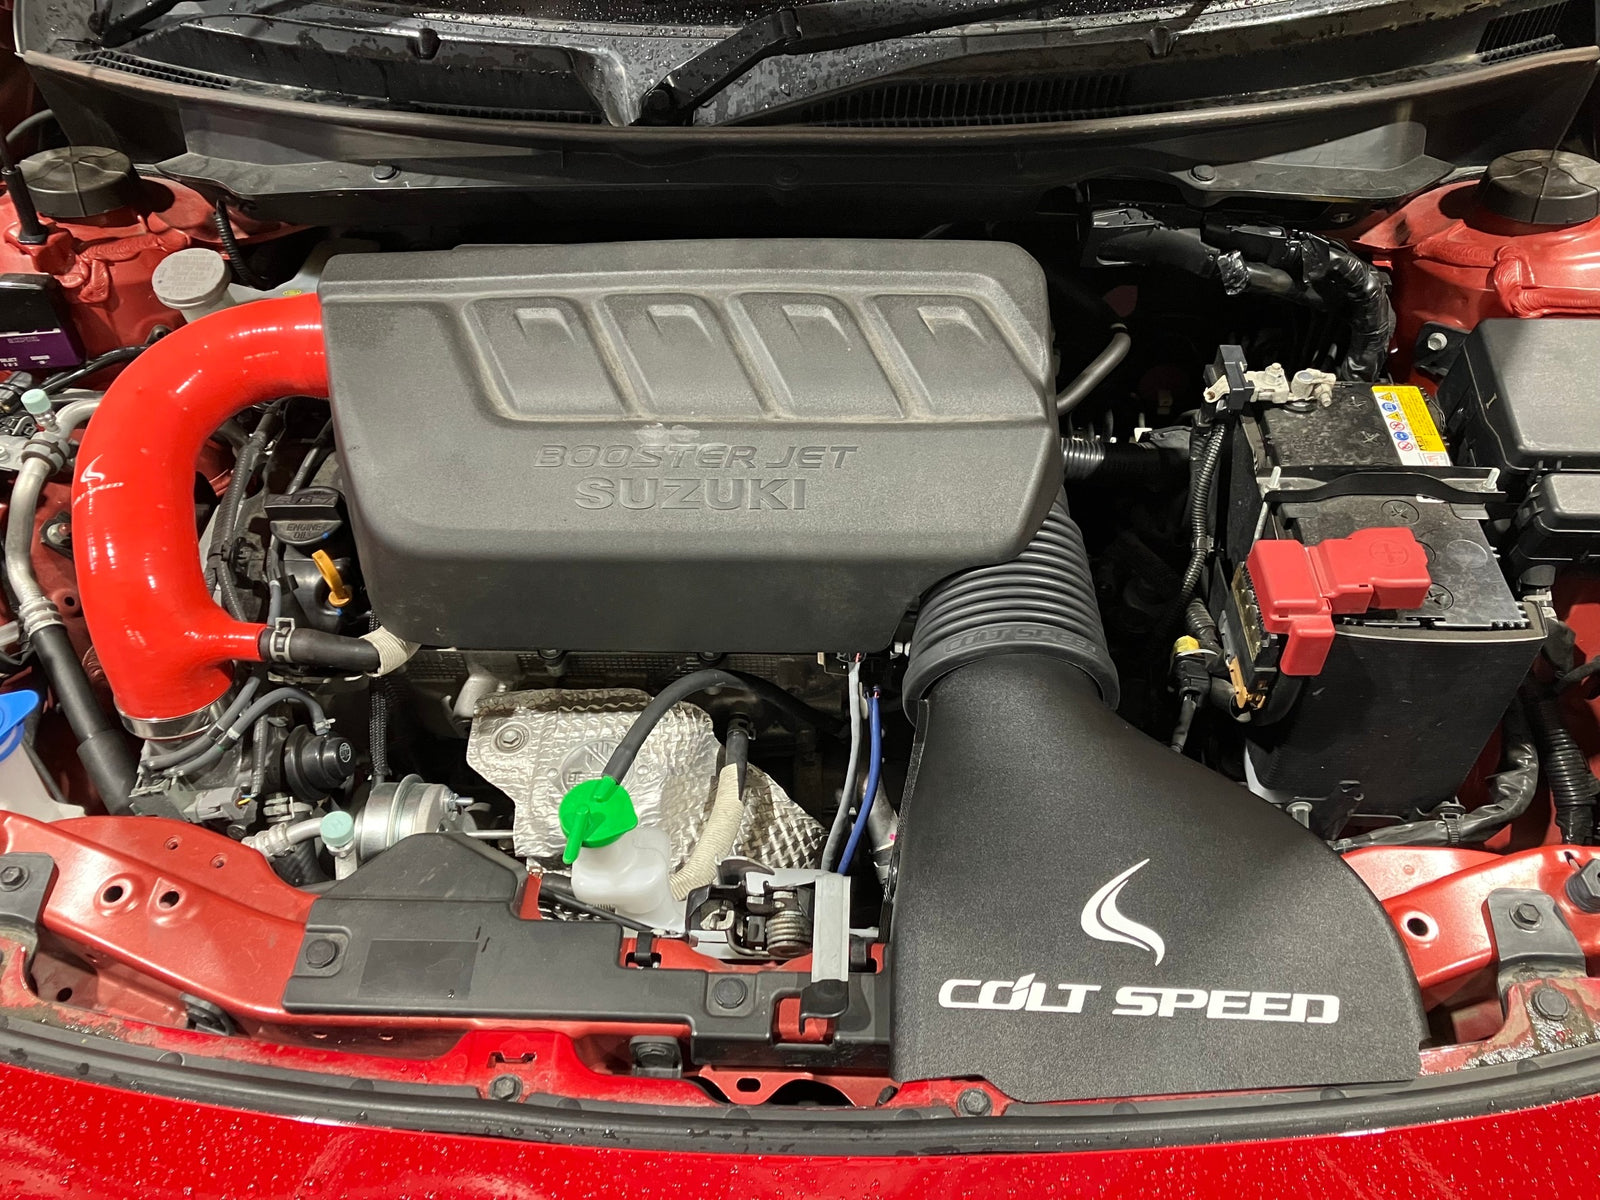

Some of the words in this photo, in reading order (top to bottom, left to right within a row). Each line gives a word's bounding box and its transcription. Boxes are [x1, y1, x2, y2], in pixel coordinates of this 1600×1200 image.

[574, 476, 806, 510] SUZUKI
[286, 523, 321, 531] ENGINE
[293, 531, 308, 539] OIL
[938, 973, 1102, 1014] COLT
[1112, 986, 1340, 1024] SPEED
